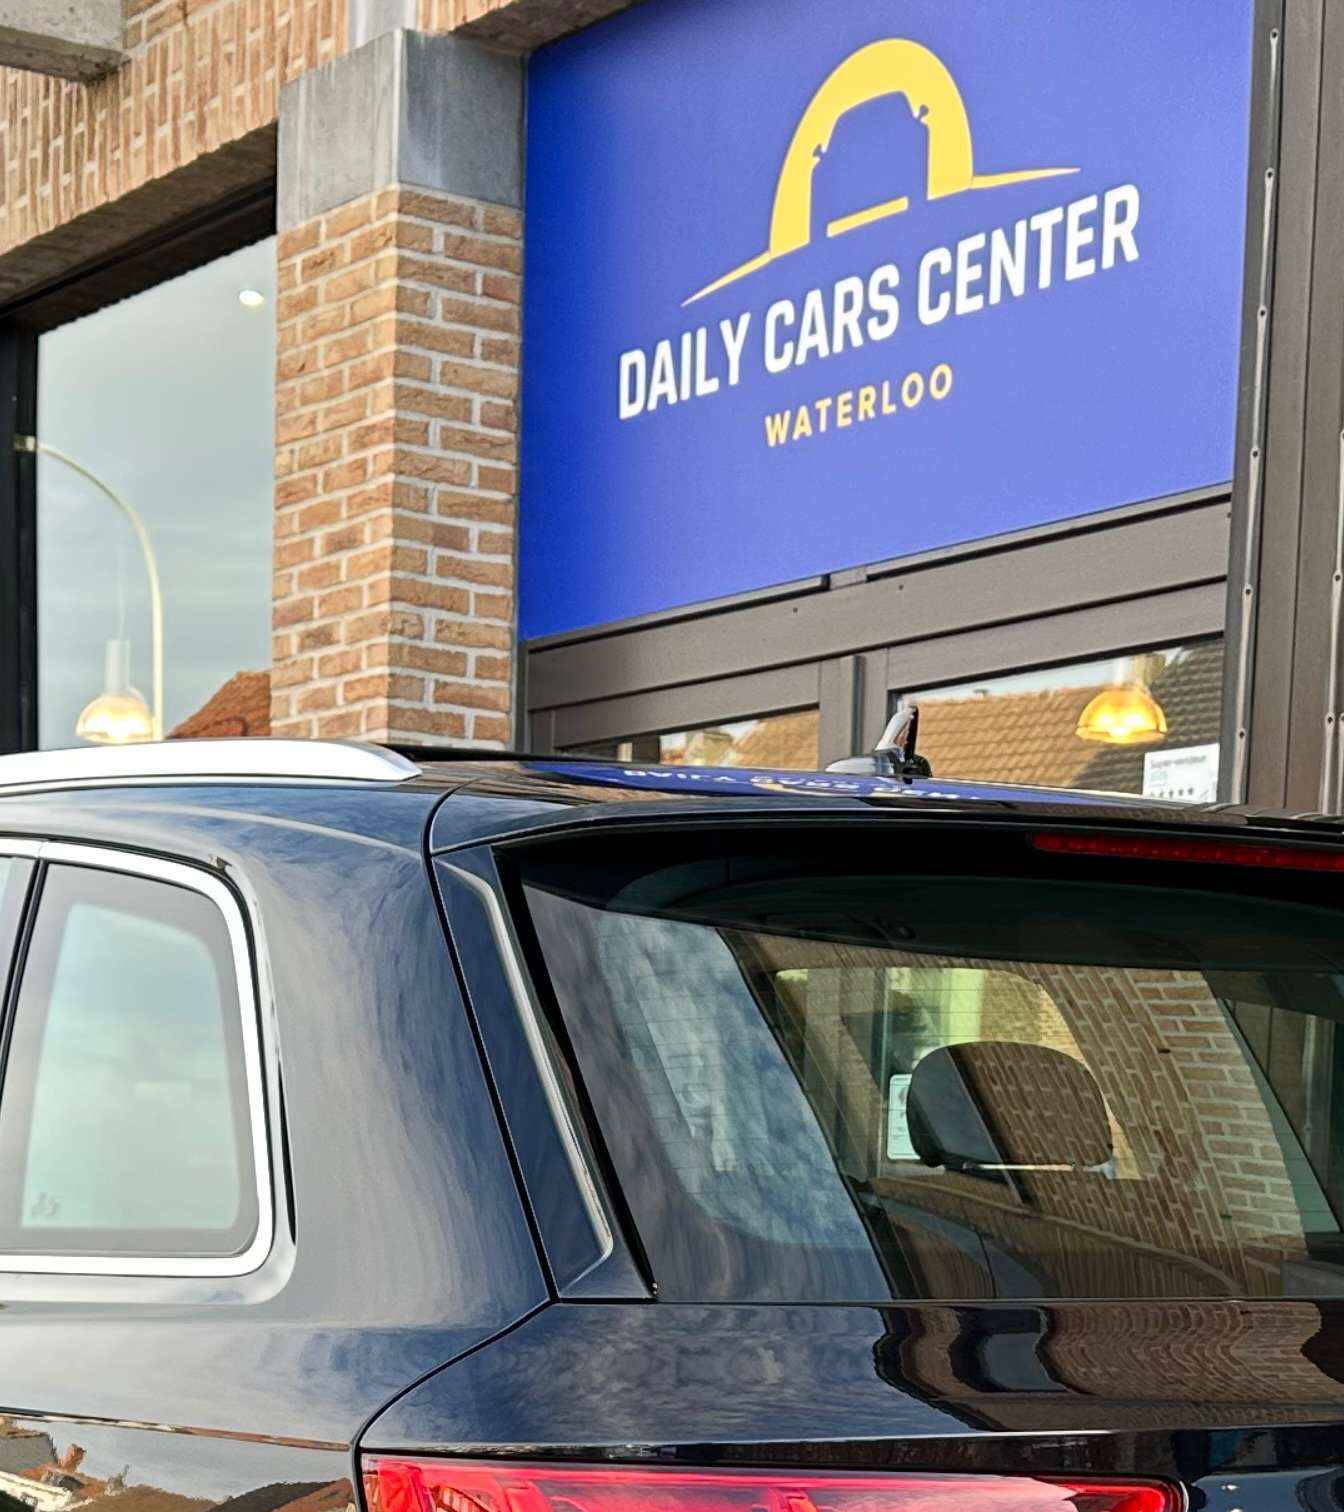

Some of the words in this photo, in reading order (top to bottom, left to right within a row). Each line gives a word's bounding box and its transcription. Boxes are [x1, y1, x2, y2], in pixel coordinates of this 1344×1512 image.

[619, 312, 751, 420] DAILY
[763, 264, 900, 373] CARS
[917, 183, 1141, 327] CENTER
[764, 363, 954, 448] WATERLOO
